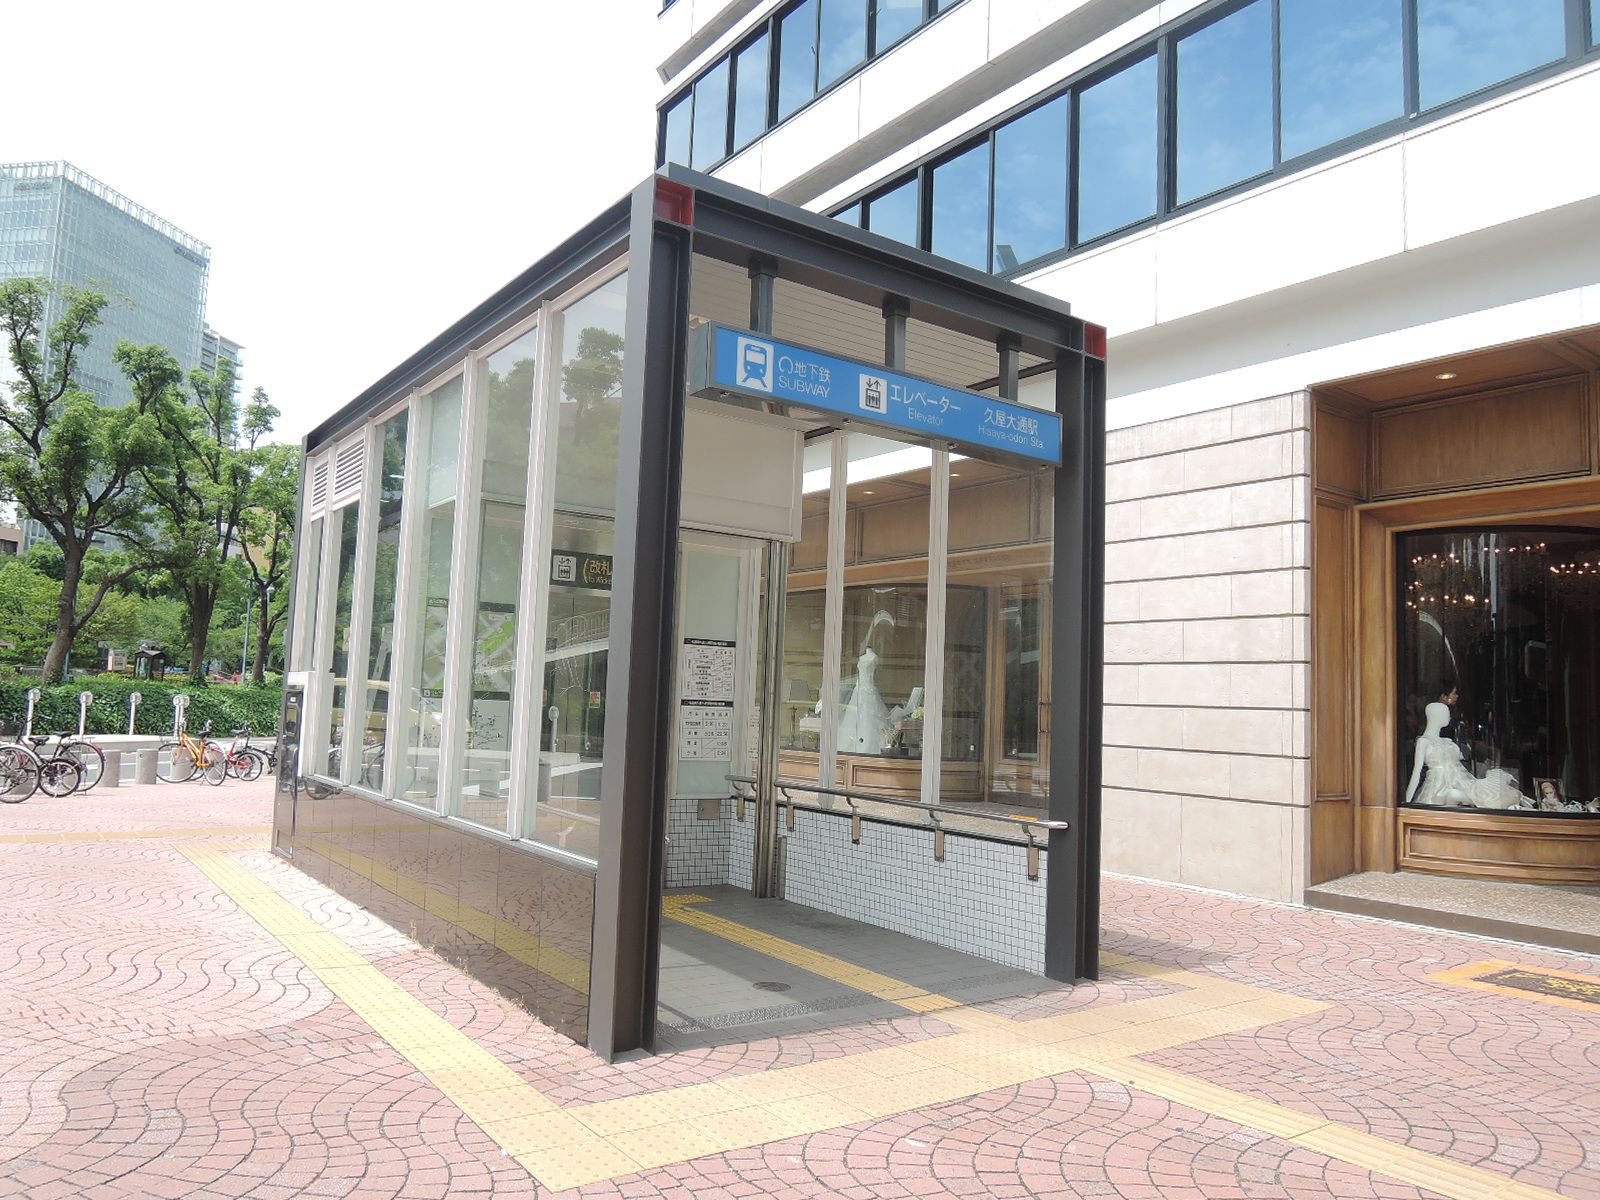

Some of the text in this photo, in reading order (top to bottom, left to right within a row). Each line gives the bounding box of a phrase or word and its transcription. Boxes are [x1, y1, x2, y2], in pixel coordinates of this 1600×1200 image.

[794, 360, 831, 385] 地下鉄
[778, 375, 831, 398] SUBWAY
[890, 384, 961, 413] エレベーター
[908, 407, 944, 426] Elevator
[983, 407, 1039, 436] 久屋大通駅
